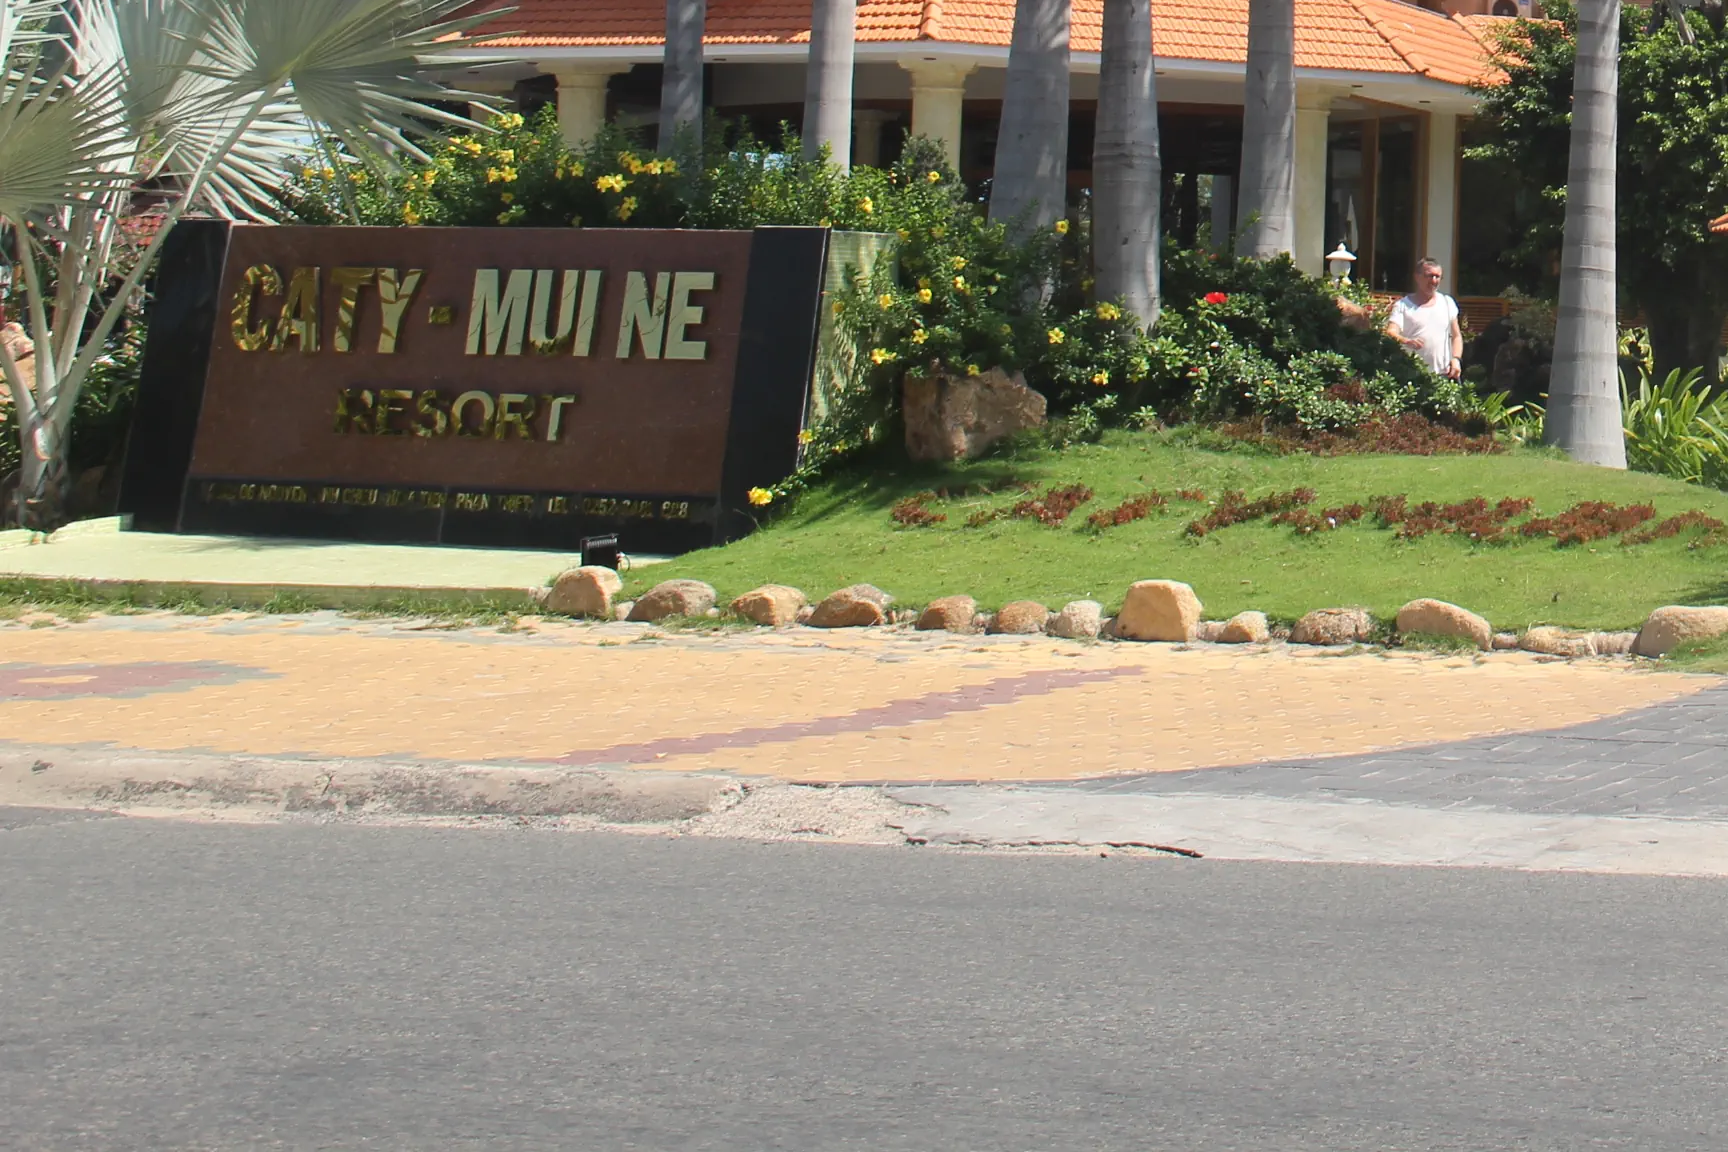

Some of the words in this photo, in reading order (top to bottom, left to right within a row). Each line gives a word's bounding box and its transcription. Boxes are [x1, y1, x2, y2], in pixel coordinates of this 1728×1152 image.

[231, 263, 425, 354] CATY
[464, 268, 602, 357] MUI
[615, 270, 716, 360] NE
[332, 387, 577, 442] RESORT
